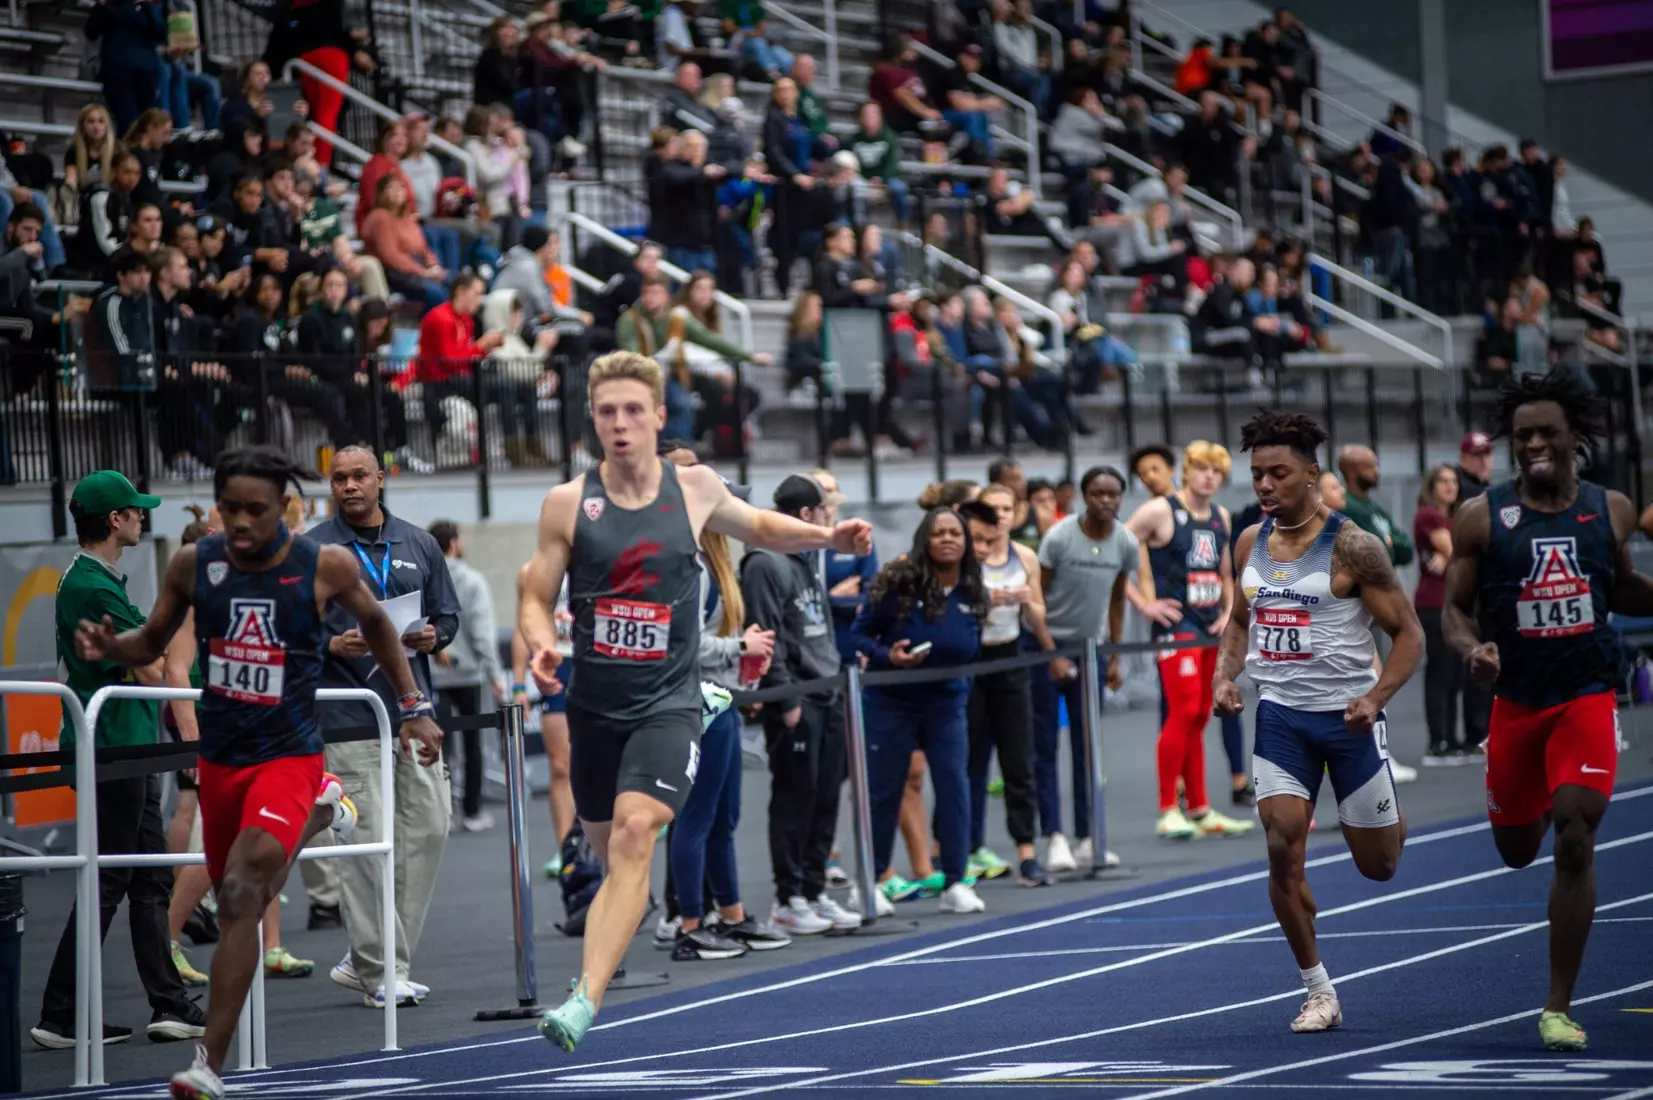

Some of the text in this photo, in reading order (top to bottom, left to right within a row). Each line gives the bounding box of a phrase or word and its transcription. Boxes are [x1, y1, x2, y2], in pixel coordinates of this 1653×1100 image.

[1520, 536, 1590, 585] A
[1554, 583, 1577, 595] OPEN
[224, 598, 278, 645] A
[633, 606, 656, 619] OPEN
[1278, 613, 1297, 623] OPEN
[1531, 598, 1582, 627] 145
[606, 619, 657, 650] 885
[1263, 626, 1301, 652] 778
[224, 645, 270, 662] WSU OPEN
[220, 662, 269, 693] 140
